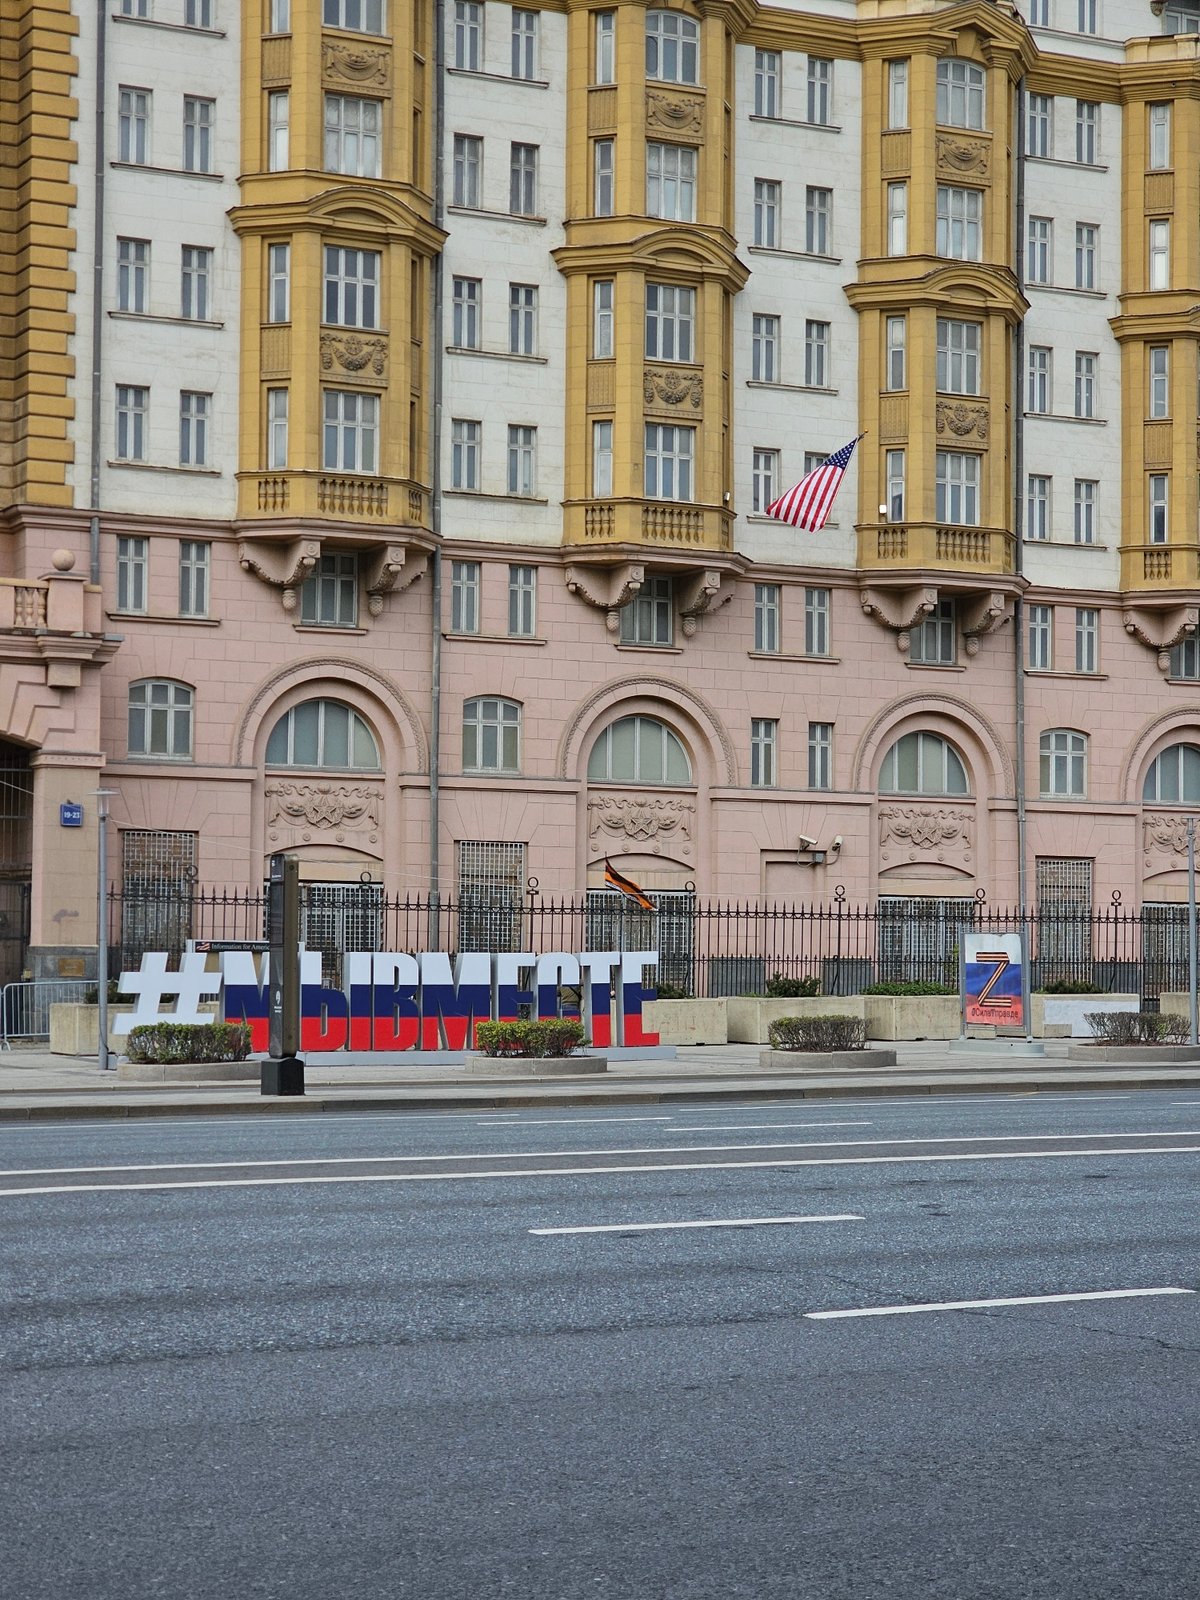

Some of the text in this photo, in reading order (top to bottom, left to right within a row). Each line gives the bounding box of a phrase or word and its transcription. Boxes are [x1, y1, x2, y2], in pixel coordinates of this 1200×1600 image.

[64, 811, 80, 819] 19-23
[211, 942, 270, 950] Information for Americ
[976, 952, 1011, 1007] Z
